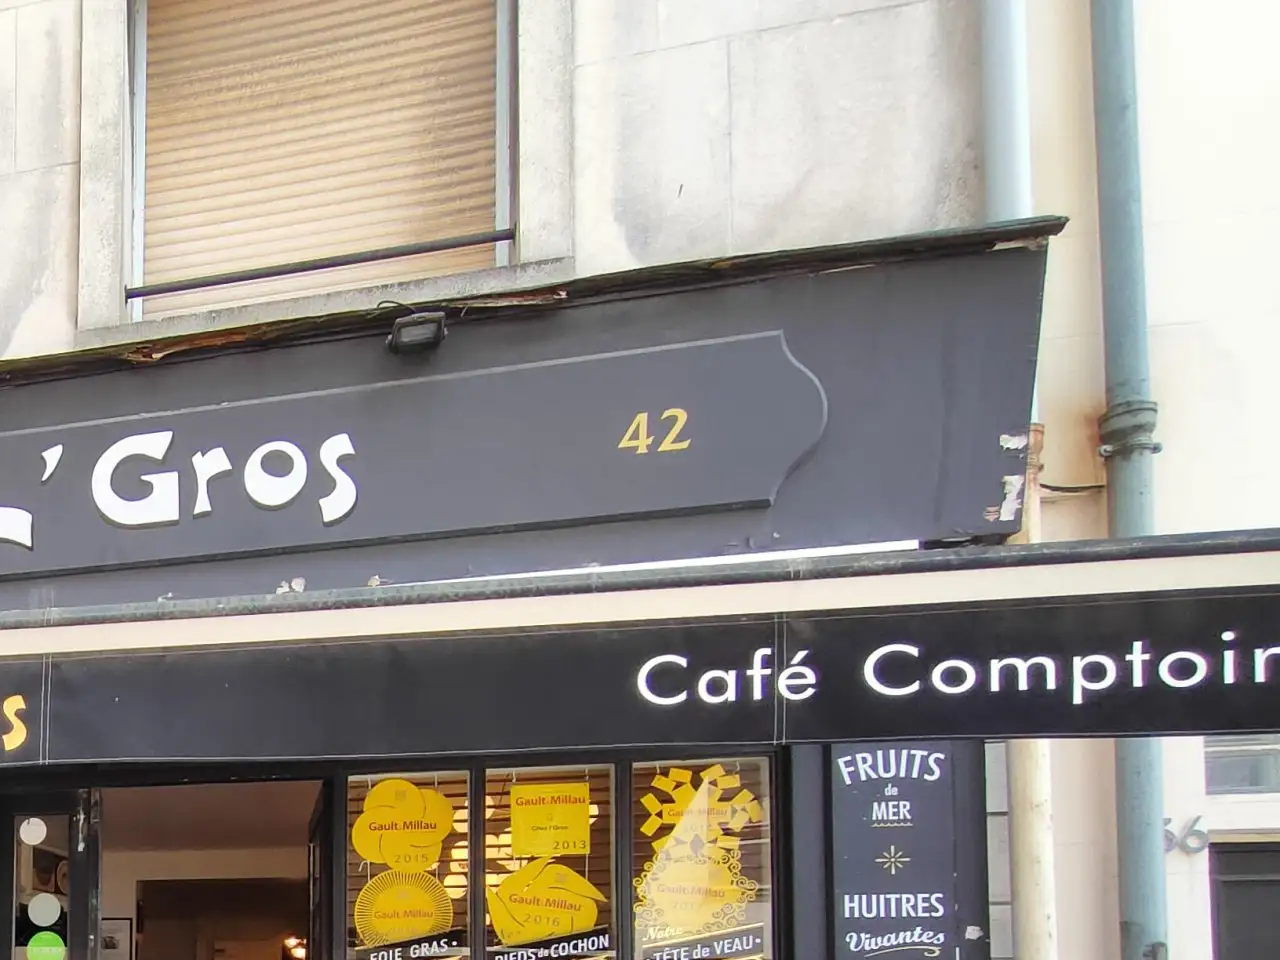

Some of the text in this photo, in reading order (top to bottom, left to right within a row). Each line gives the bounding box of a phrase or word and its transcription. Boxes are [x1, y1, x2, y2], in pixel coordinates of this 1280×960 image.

[617, 408, 693, 456] 42
[637, 647, 818, 705] Café
[837, 749, 946, 785] FRUITS
[884, 783, 898, 796] de
[872, 801, 911, 820] MER
[553, 840, 587, 850] 2013
[394, 854, 429, 864] 2015
[843, 893, 945, 918] HUITRES
[523, 914, 561, 926] 2016
[410, 938, 449, 958] GRAS
[549, 934, 610, 958] COCHON
[692, 944, 710, 959] de
[713, 935, 754, 955] VEAU
[845, 926, 946, 952] Vivantes
